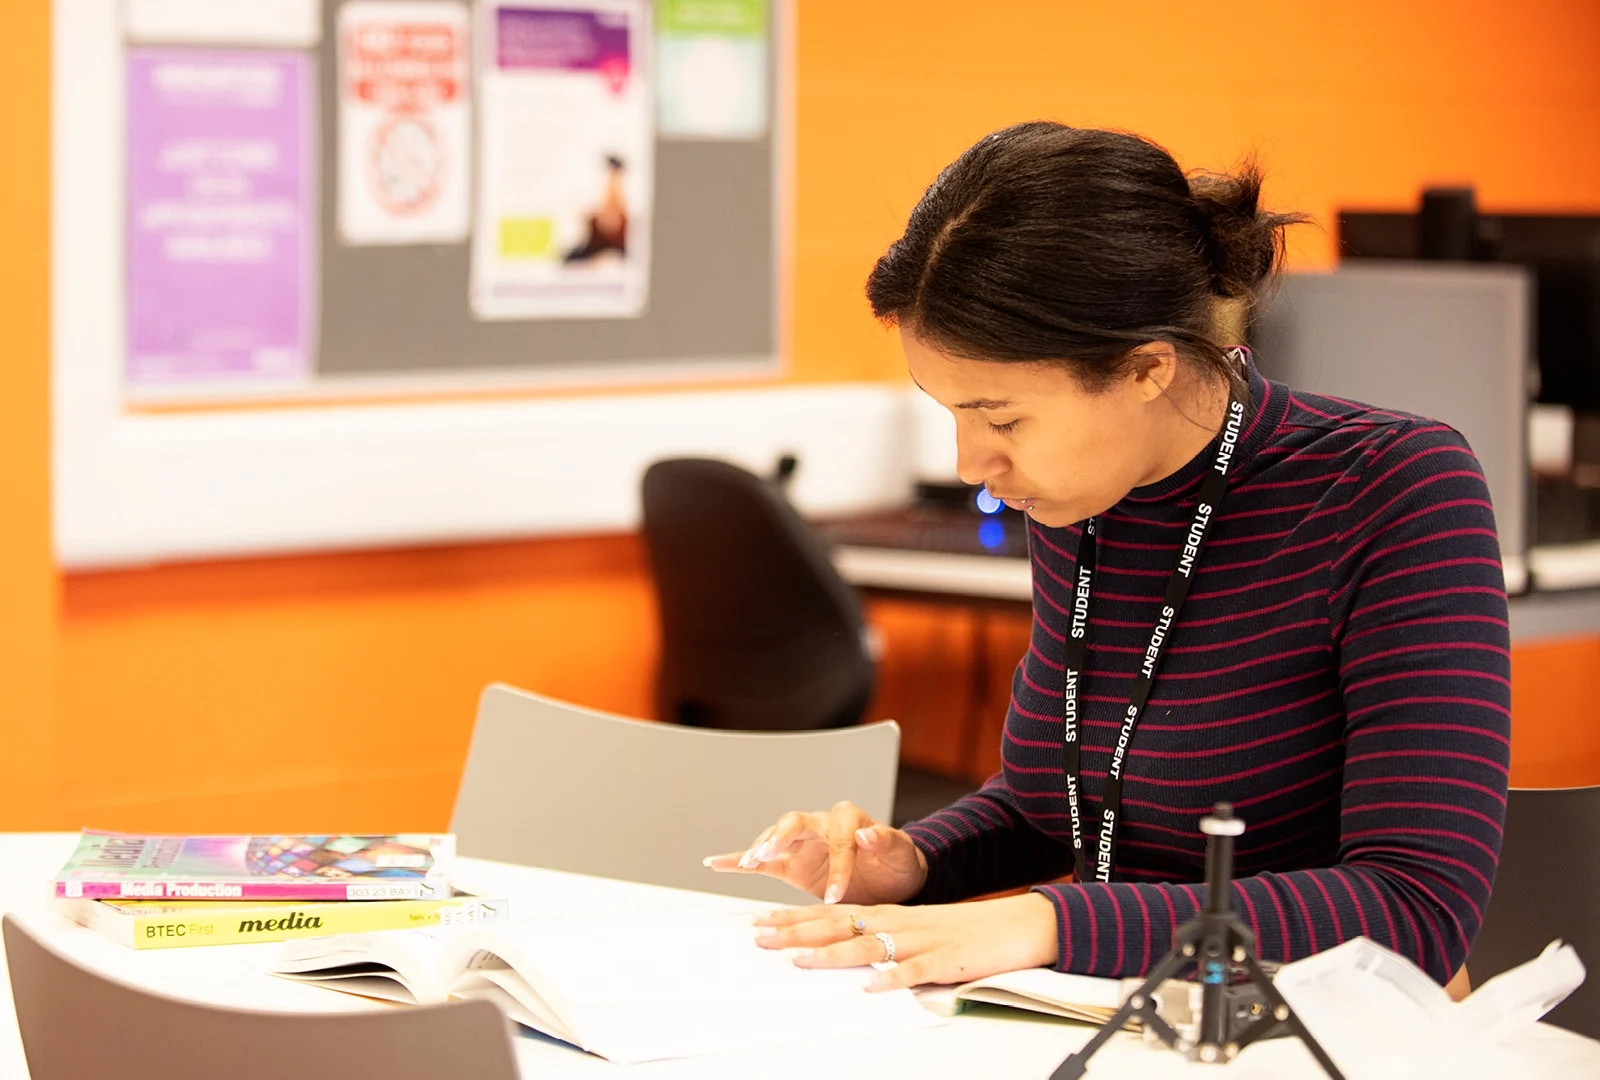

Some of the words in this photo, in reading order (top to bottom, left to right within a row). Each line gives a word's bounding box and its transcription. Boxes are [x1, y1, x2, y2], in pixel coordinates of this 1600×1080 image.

[1214, 400, 1244, 475] STUDENT
[1178, 502, 1212, 577] STUDENT
[1071, 565, 1092, 639] STUDENT
[1141, 605, 1175, 678] STUDENT
[1065, 668, 1079, 743] STUDENT
[1110, 704, 1138, 780] STUDENT
[1067, 774, 1082, 849] STUDENT
[1095, 808, 1115, 883] STUDENT
[121, 882, 164, 897] Media
[167, 882, 242, 897] Production
[238, 911, 324, 933] media
[389, 887, 413, 896] BAY
[146, 924, 186, 938] BTEC
[189, 923, 214, 936] First
